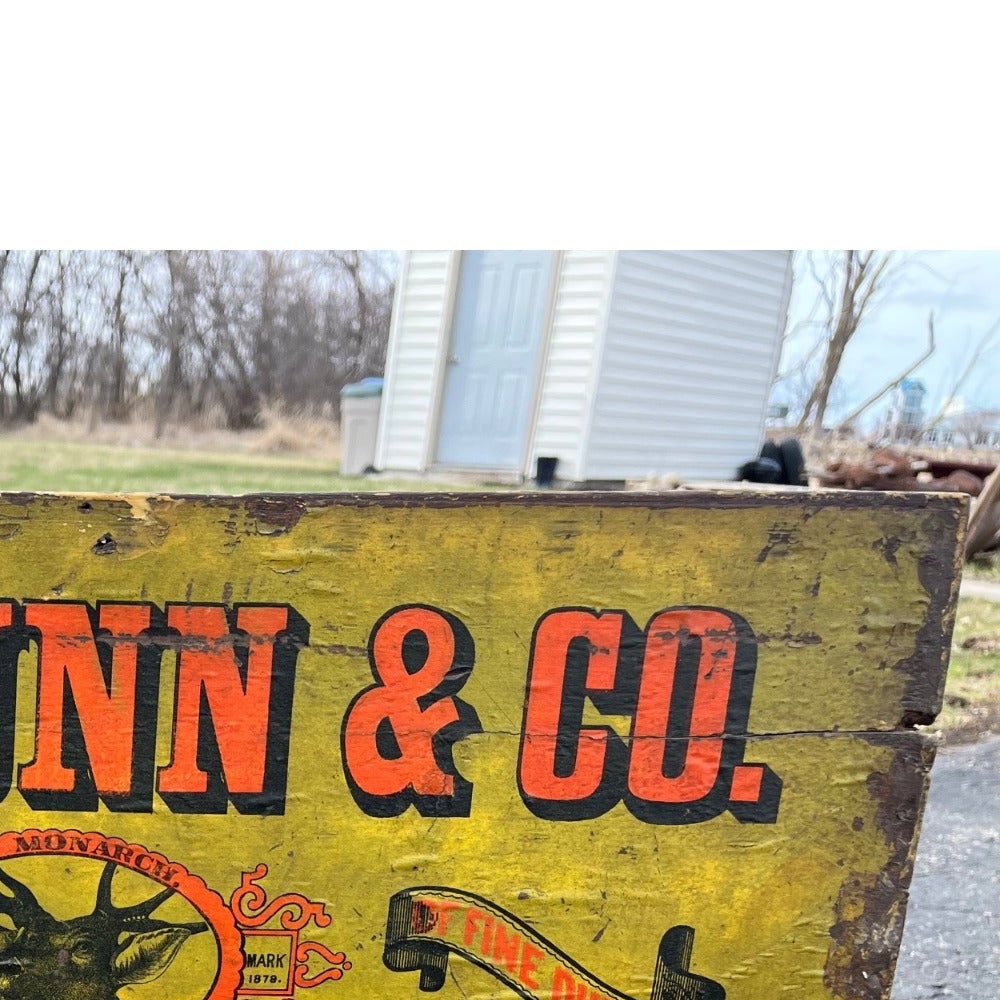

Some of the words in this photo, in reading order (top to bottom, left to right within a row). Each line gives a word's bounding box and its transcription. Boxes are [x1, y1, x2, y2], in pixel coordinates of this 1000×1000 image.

[340, 603, 483, 818] &
[516, 605, 784, 825] CO.
[246, 953, 287, 969] MARK
[463, 907, 546, 990] FINE
